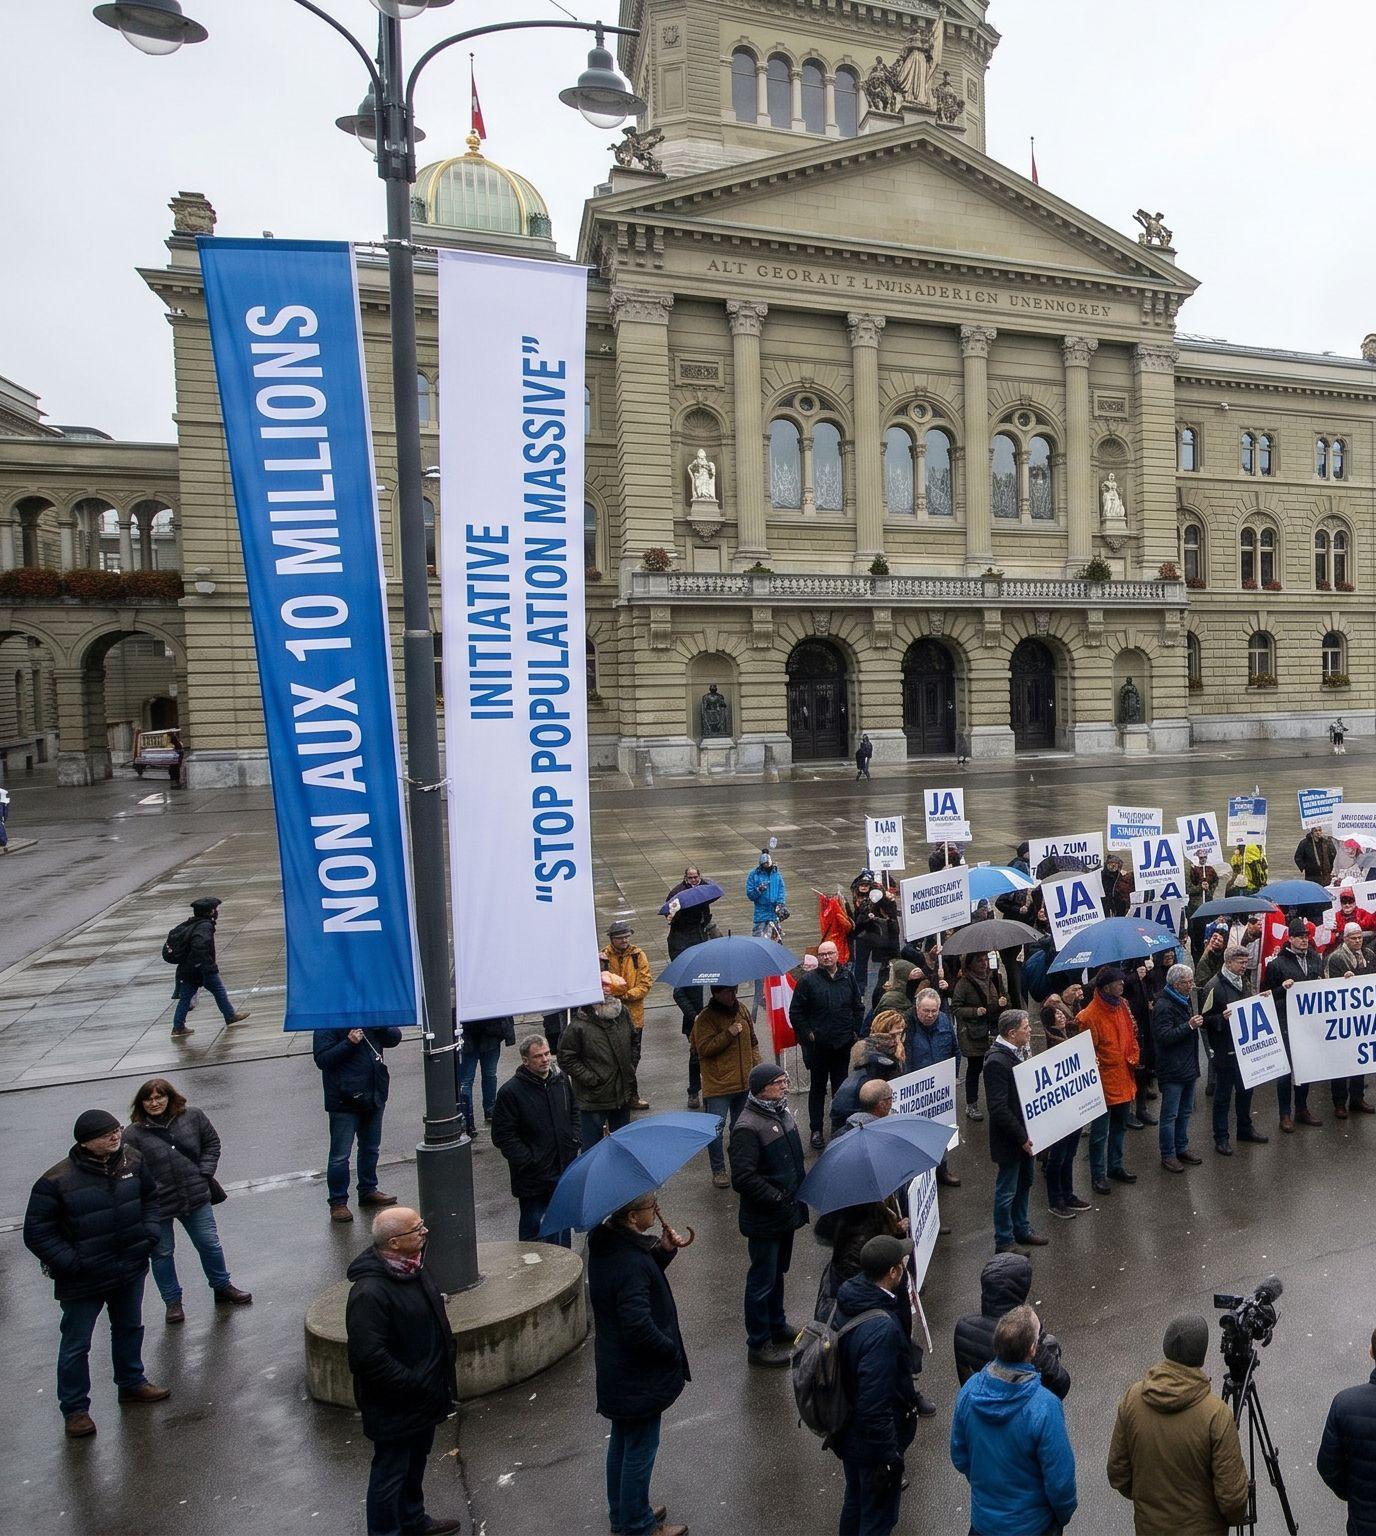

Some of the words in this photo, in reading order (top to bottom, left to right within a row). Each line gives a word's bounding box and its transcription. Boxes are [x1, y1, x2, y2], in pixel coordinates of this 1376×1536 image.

[245, 305, 343, 575] MILLIONS
[280, 594, 352, 662] 10
[465, 524, 514, 719] INITIATIVE
[524, 537, 572, 773] POPULATION
[290, 677, 366, 793] AUX
[929, 792, 958, 816] JA
[1042, 844, 1059, 858] JA
[1063, 841, 1087, 855] ZUM
[1139, 839, 1177, 871] JA
[1185, 817, 1215, 845] JA
[310, 813, 382, 933] NON
[1054, 881, 1096, 920] JA
[1237, 1001, 1275, 1046] JA
[1024, 1068, 1098, 1121] BEGRENZUNG
[1034, 1066, 1053, 1094] JA
[1054, 1053, 1081, 1083] ZUM
